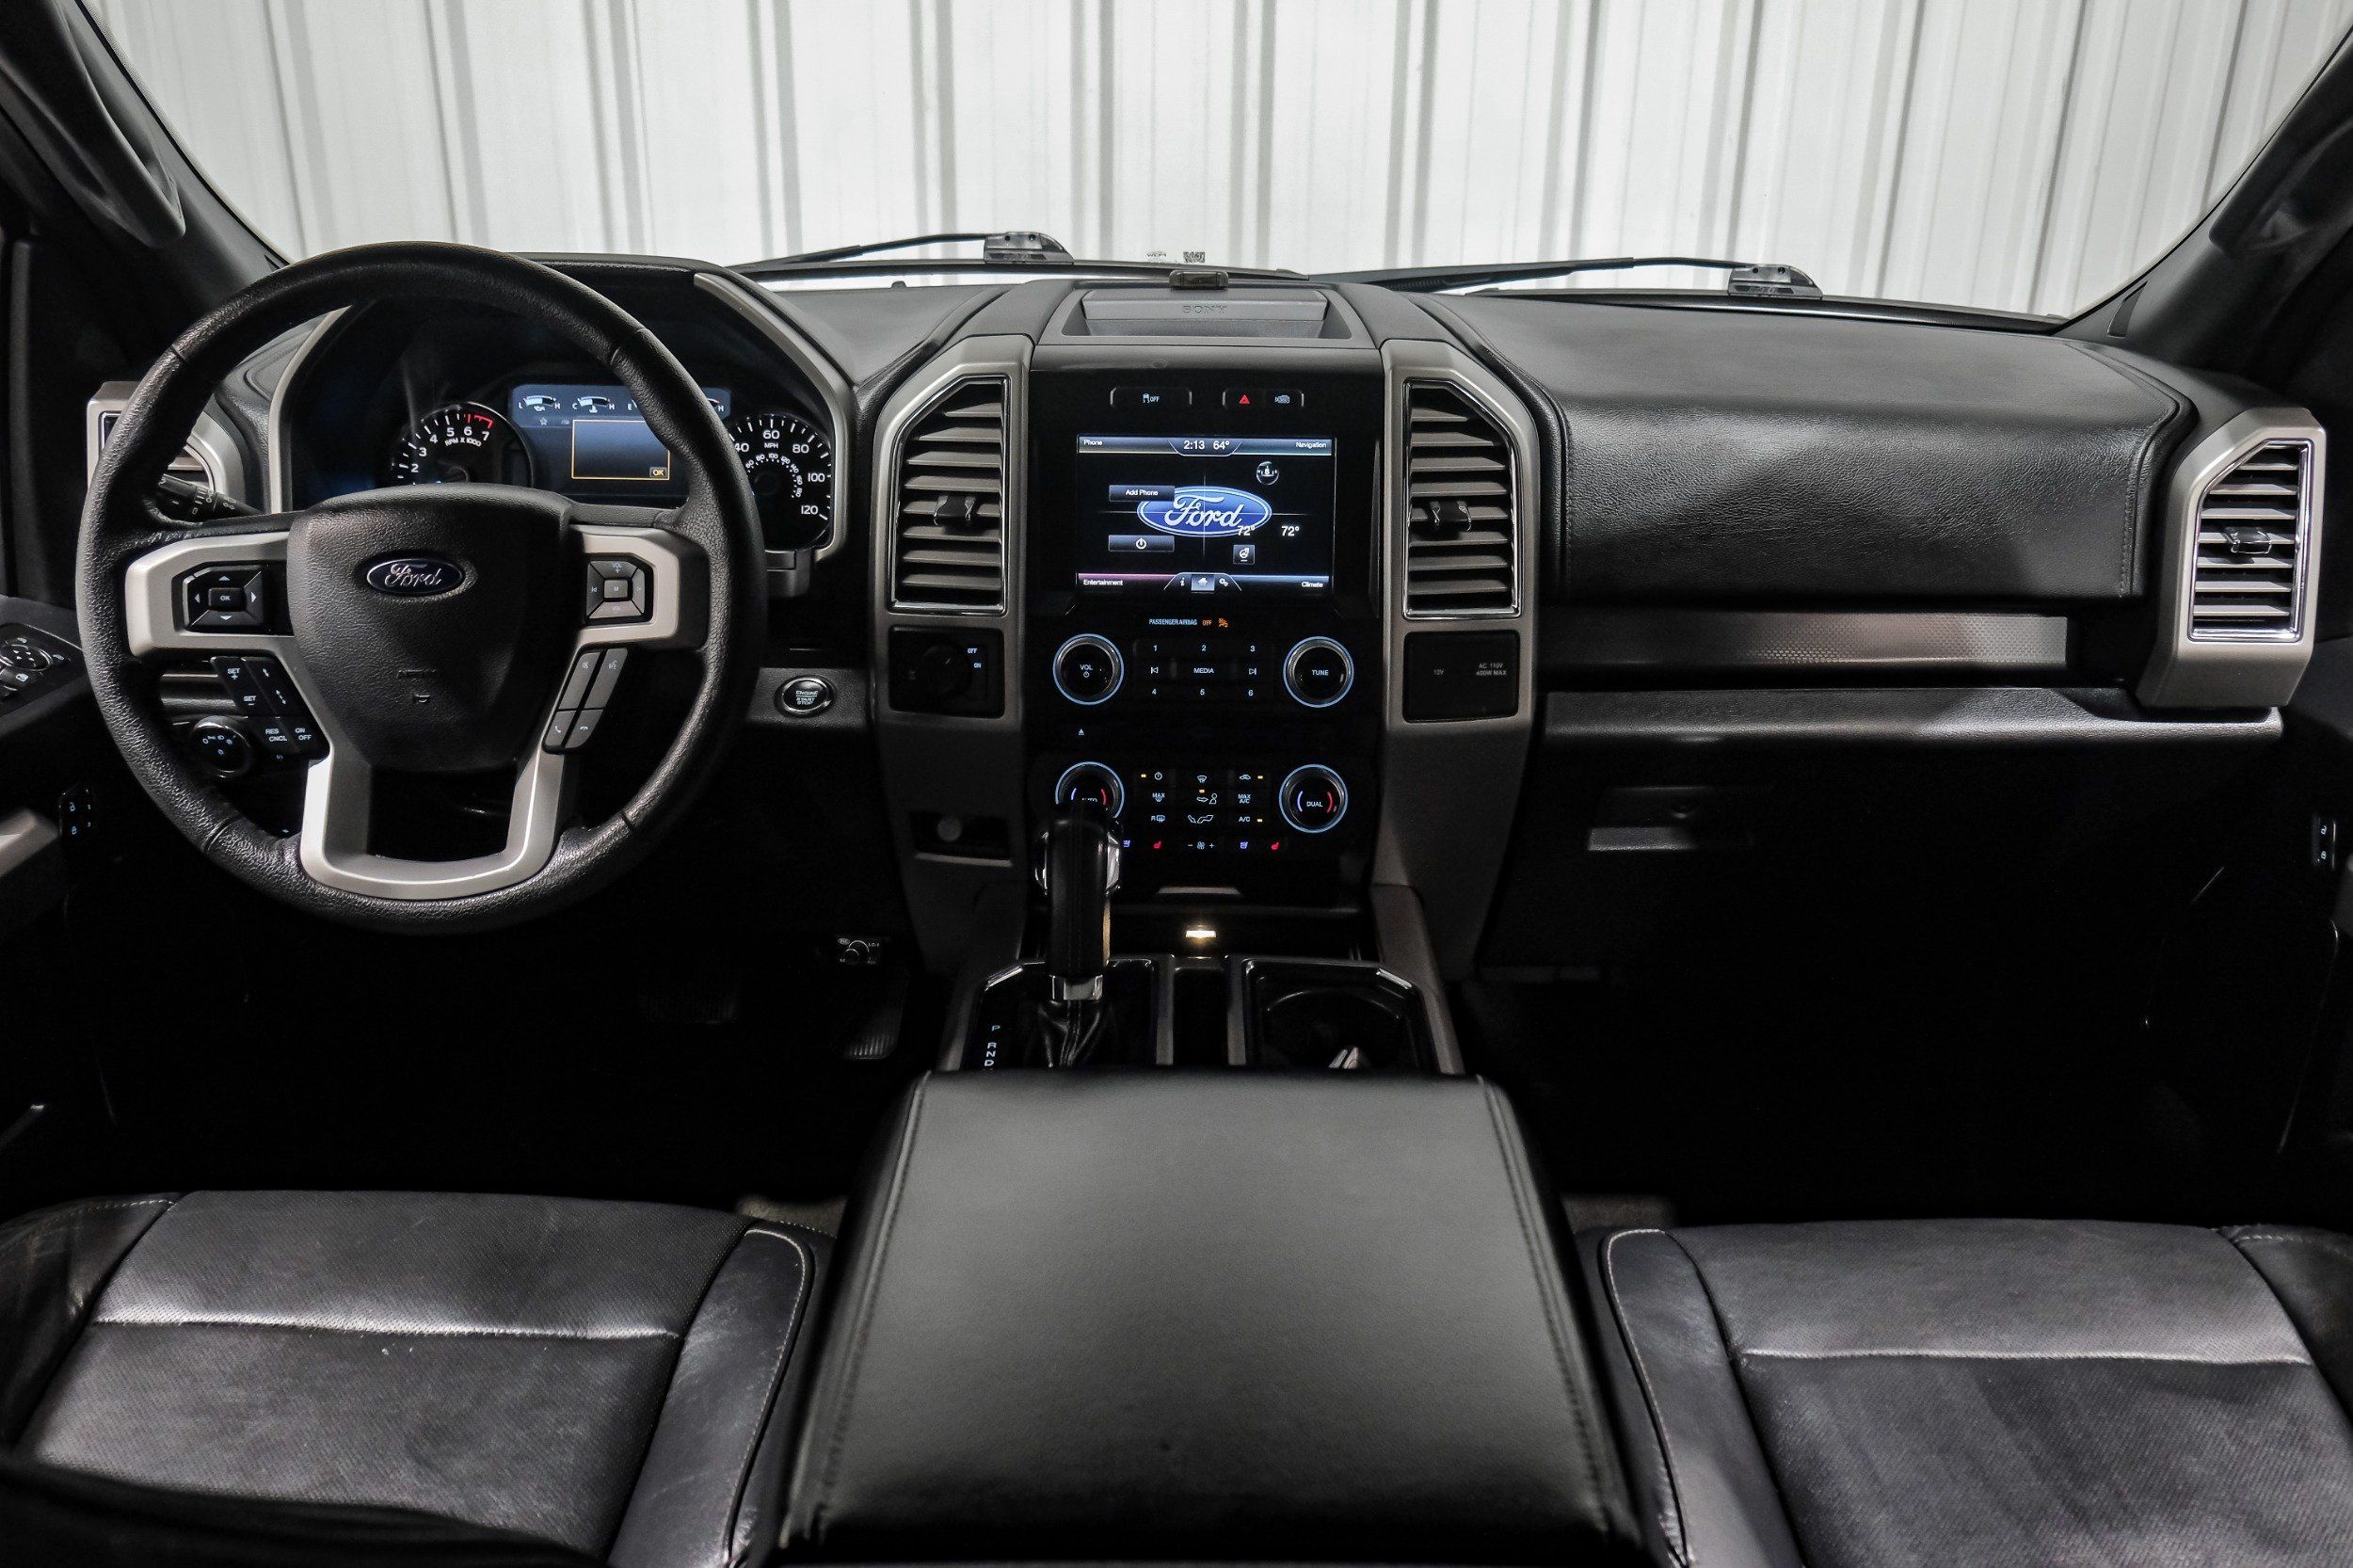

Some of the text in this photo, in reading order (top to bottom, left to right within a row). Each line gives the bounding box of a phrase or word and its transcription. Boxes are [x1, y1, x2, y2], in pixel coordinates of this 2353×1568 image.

[1182, 305, 1227, 314] SONY
[446, 427, 455, 437] 5
[463, 426, 472, 436] 6
[482, 431, 490, 440] 7
[762, 430, 780, 440] 60
[429, 434, 439, 443] 4
[444, 438, 458, 447] RPM
[734, 443, 749, 453] 40
[792, 444, 809, 454] 80
[1183, 440, 1206, 450] 2:13
[1295, 441, 1327, 450] Navigation
[419, 447, 427, 457] 3
[411, 463, 419, 473] 2
[808, 472, 825, 483] 100
[801, 505, 819, 515] 120
[1164, 494, 1245, 528] Ford
[384, 563, 441, 586] Ford
[1201, 644, 1207, 652] 2
